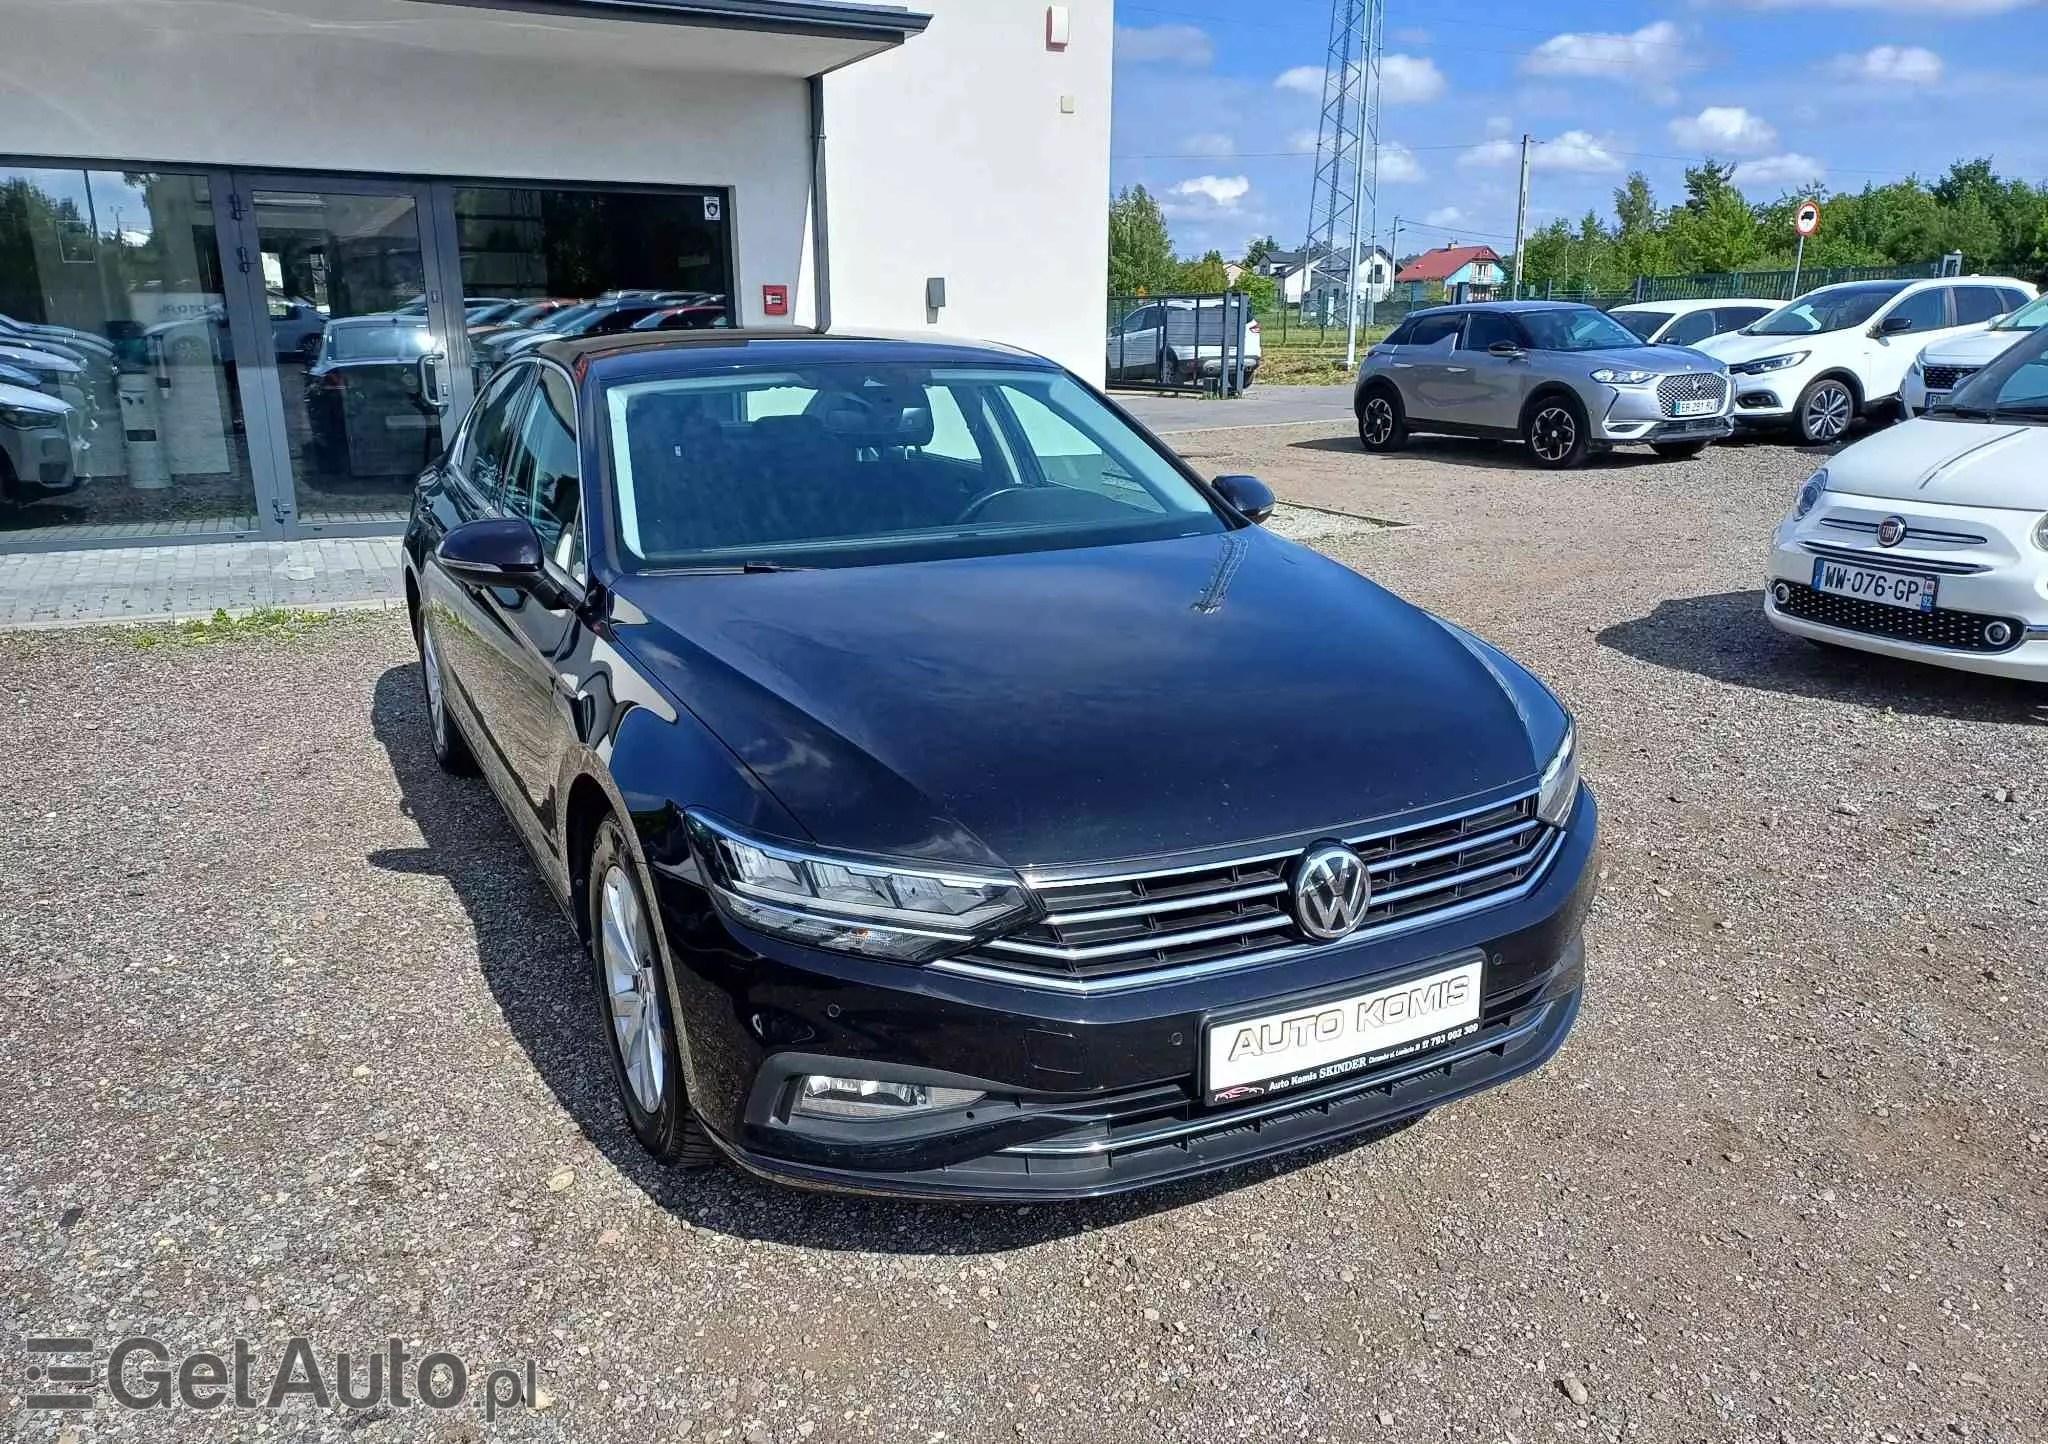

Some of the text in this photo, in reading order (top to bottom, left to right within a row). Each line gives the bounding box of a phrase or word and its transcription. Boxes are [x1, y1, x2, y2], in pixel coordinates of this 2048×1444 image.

[1824, 565, 1919, 602] WW-076-GP
[1228, 974, 1471, 1062] AUTO KOMIS
[1268, 1079, 1290, 1091] Auto
[1291, 1072, 1318, 1085] Komis
[1319, 1057, 1367, 1079] SKINDER
